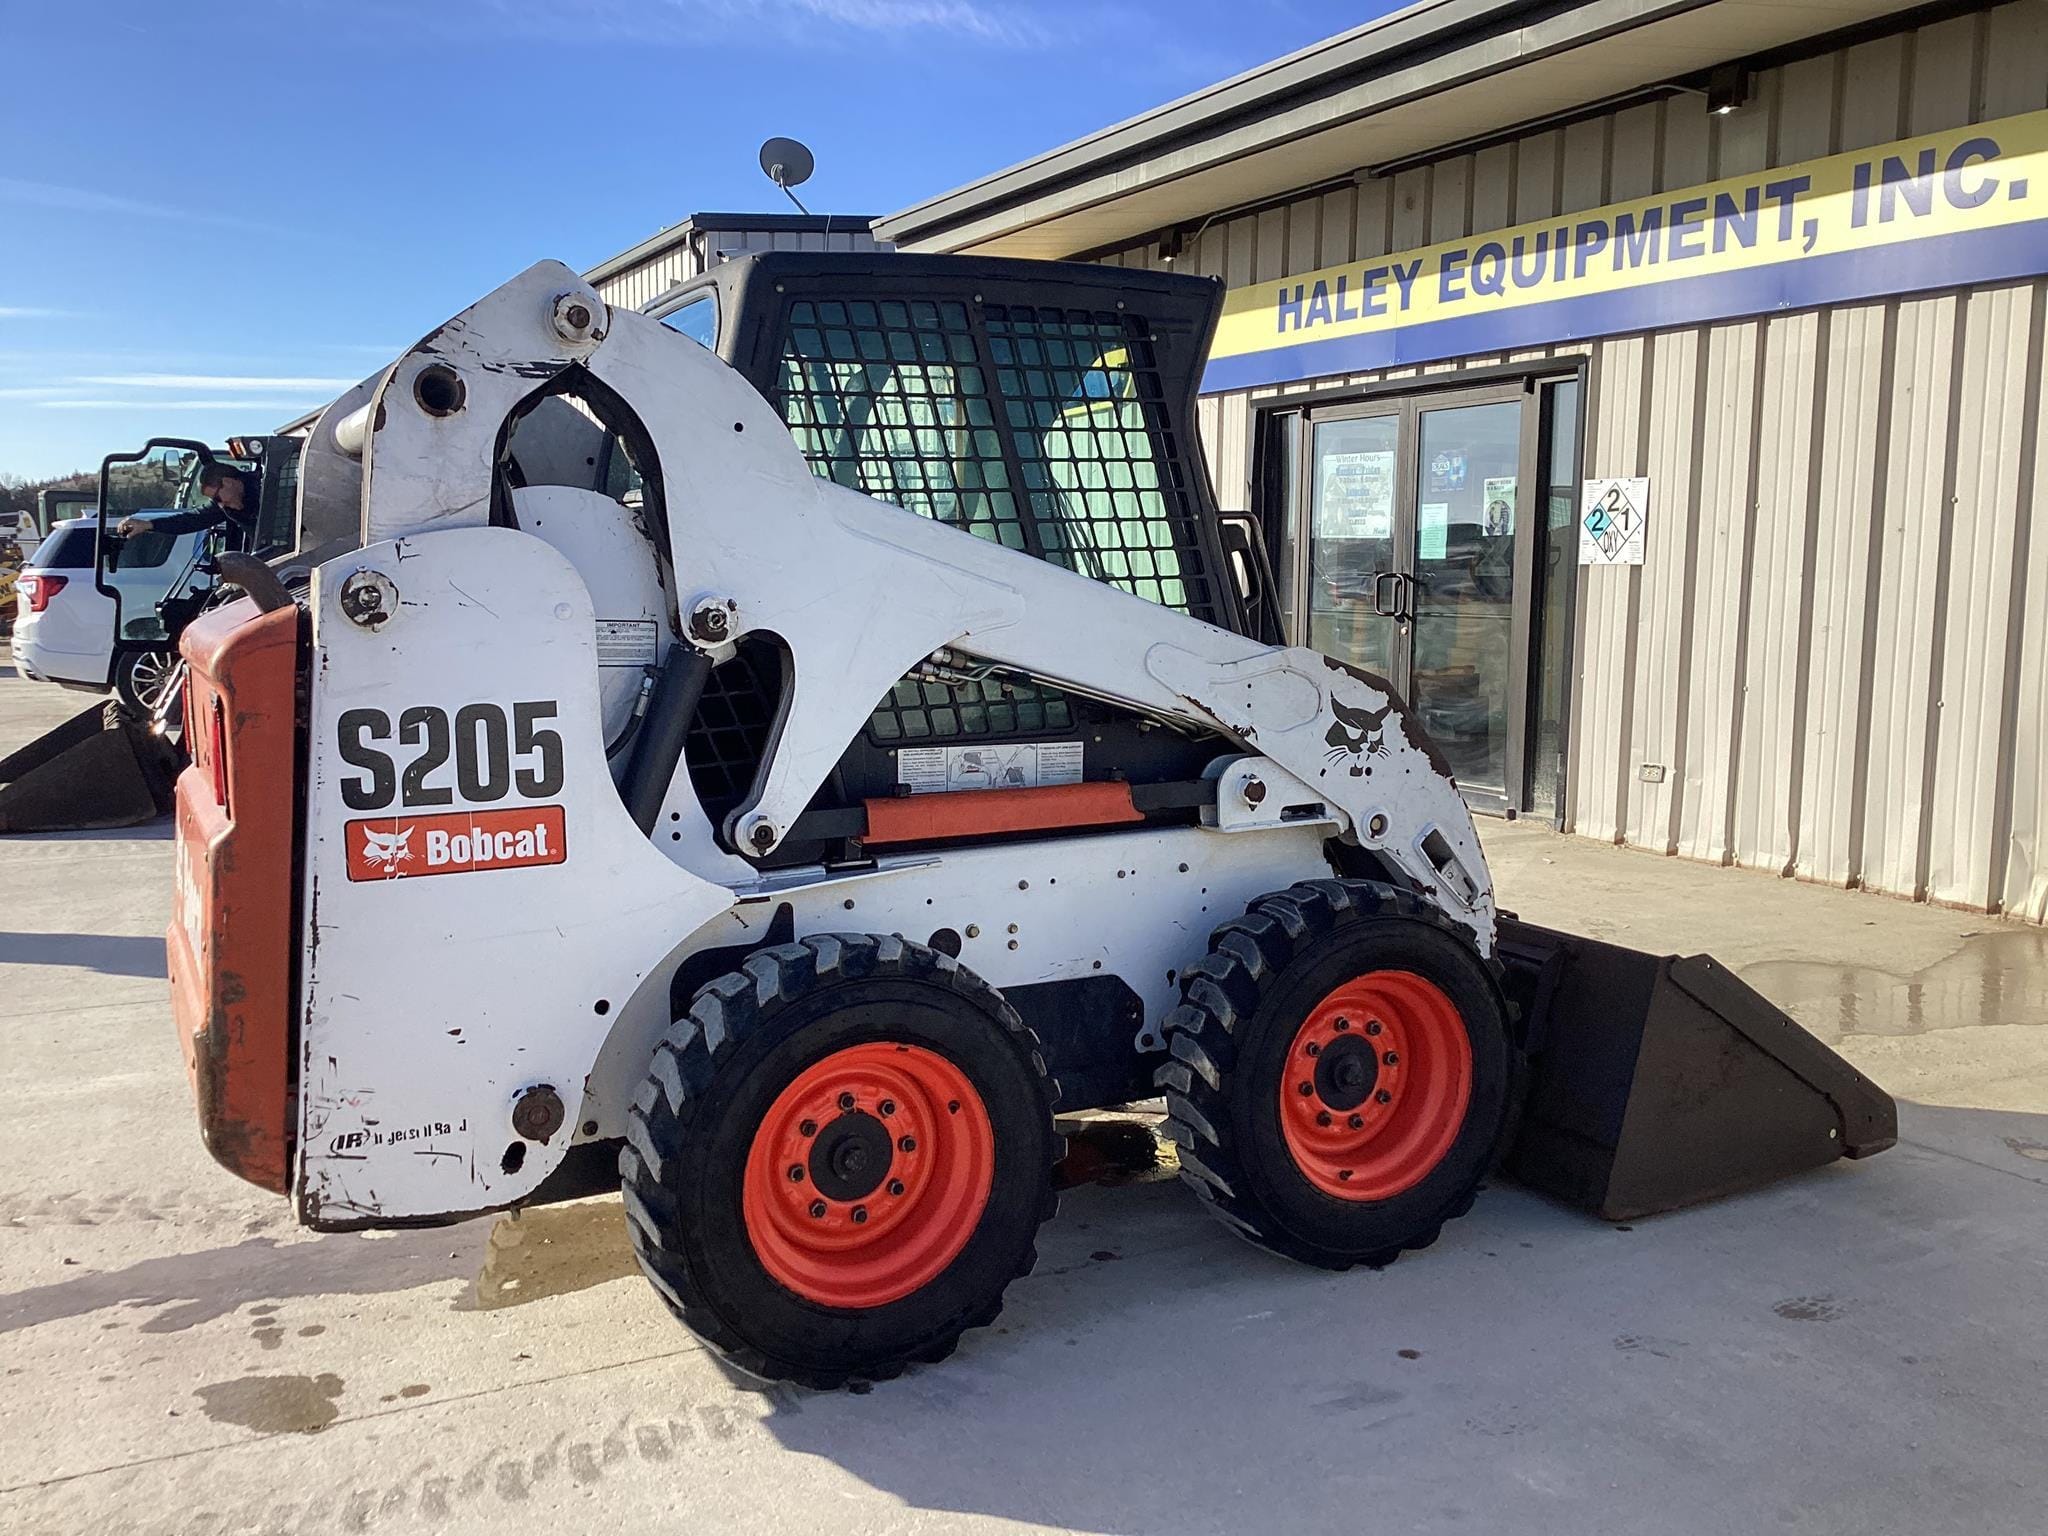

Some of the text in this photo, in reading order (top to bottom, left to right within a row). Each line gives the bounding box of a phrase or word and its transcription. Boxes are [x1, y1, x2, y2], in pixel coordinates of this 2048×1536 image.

[1278, 137, 2030, 333] HALEY EQUIPMENT, INC.
[1336, 454, 1381, 464] Winter Hours
[1607, 488, 1620, 512] 2
[1591, 508, 1630, 532] 2 1
[1603, 530, 1618, 554] OXY
[337, 700, 564, 811] S205
[426, 823, 549, 867] Bobcat
